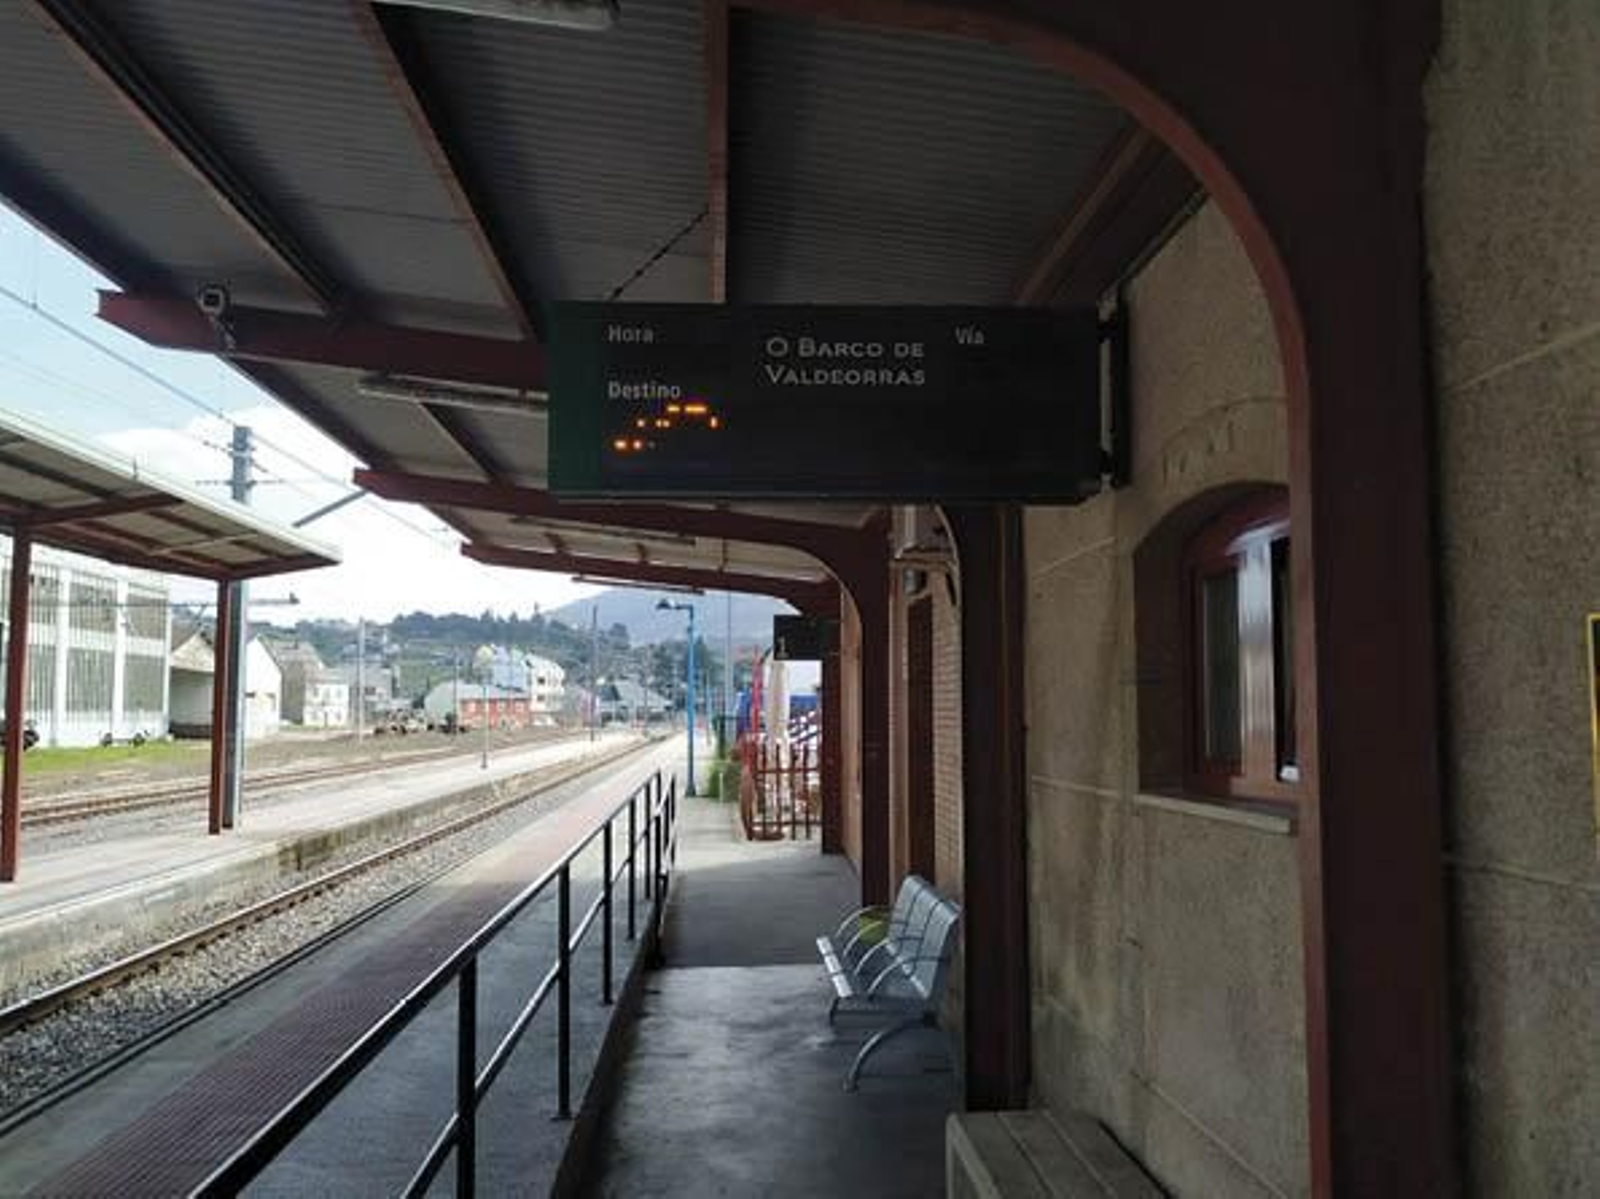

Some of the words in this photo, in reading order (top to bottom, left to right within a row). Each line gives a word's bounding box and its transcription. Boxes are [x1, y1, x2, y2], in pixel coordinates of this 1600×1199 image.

[608, 324, 654, 342] Hora
[765, 336, 789, 358] O
[764, 363, 926, 386] VALDEORRAS
[608, 378, 682, 398] Destino
